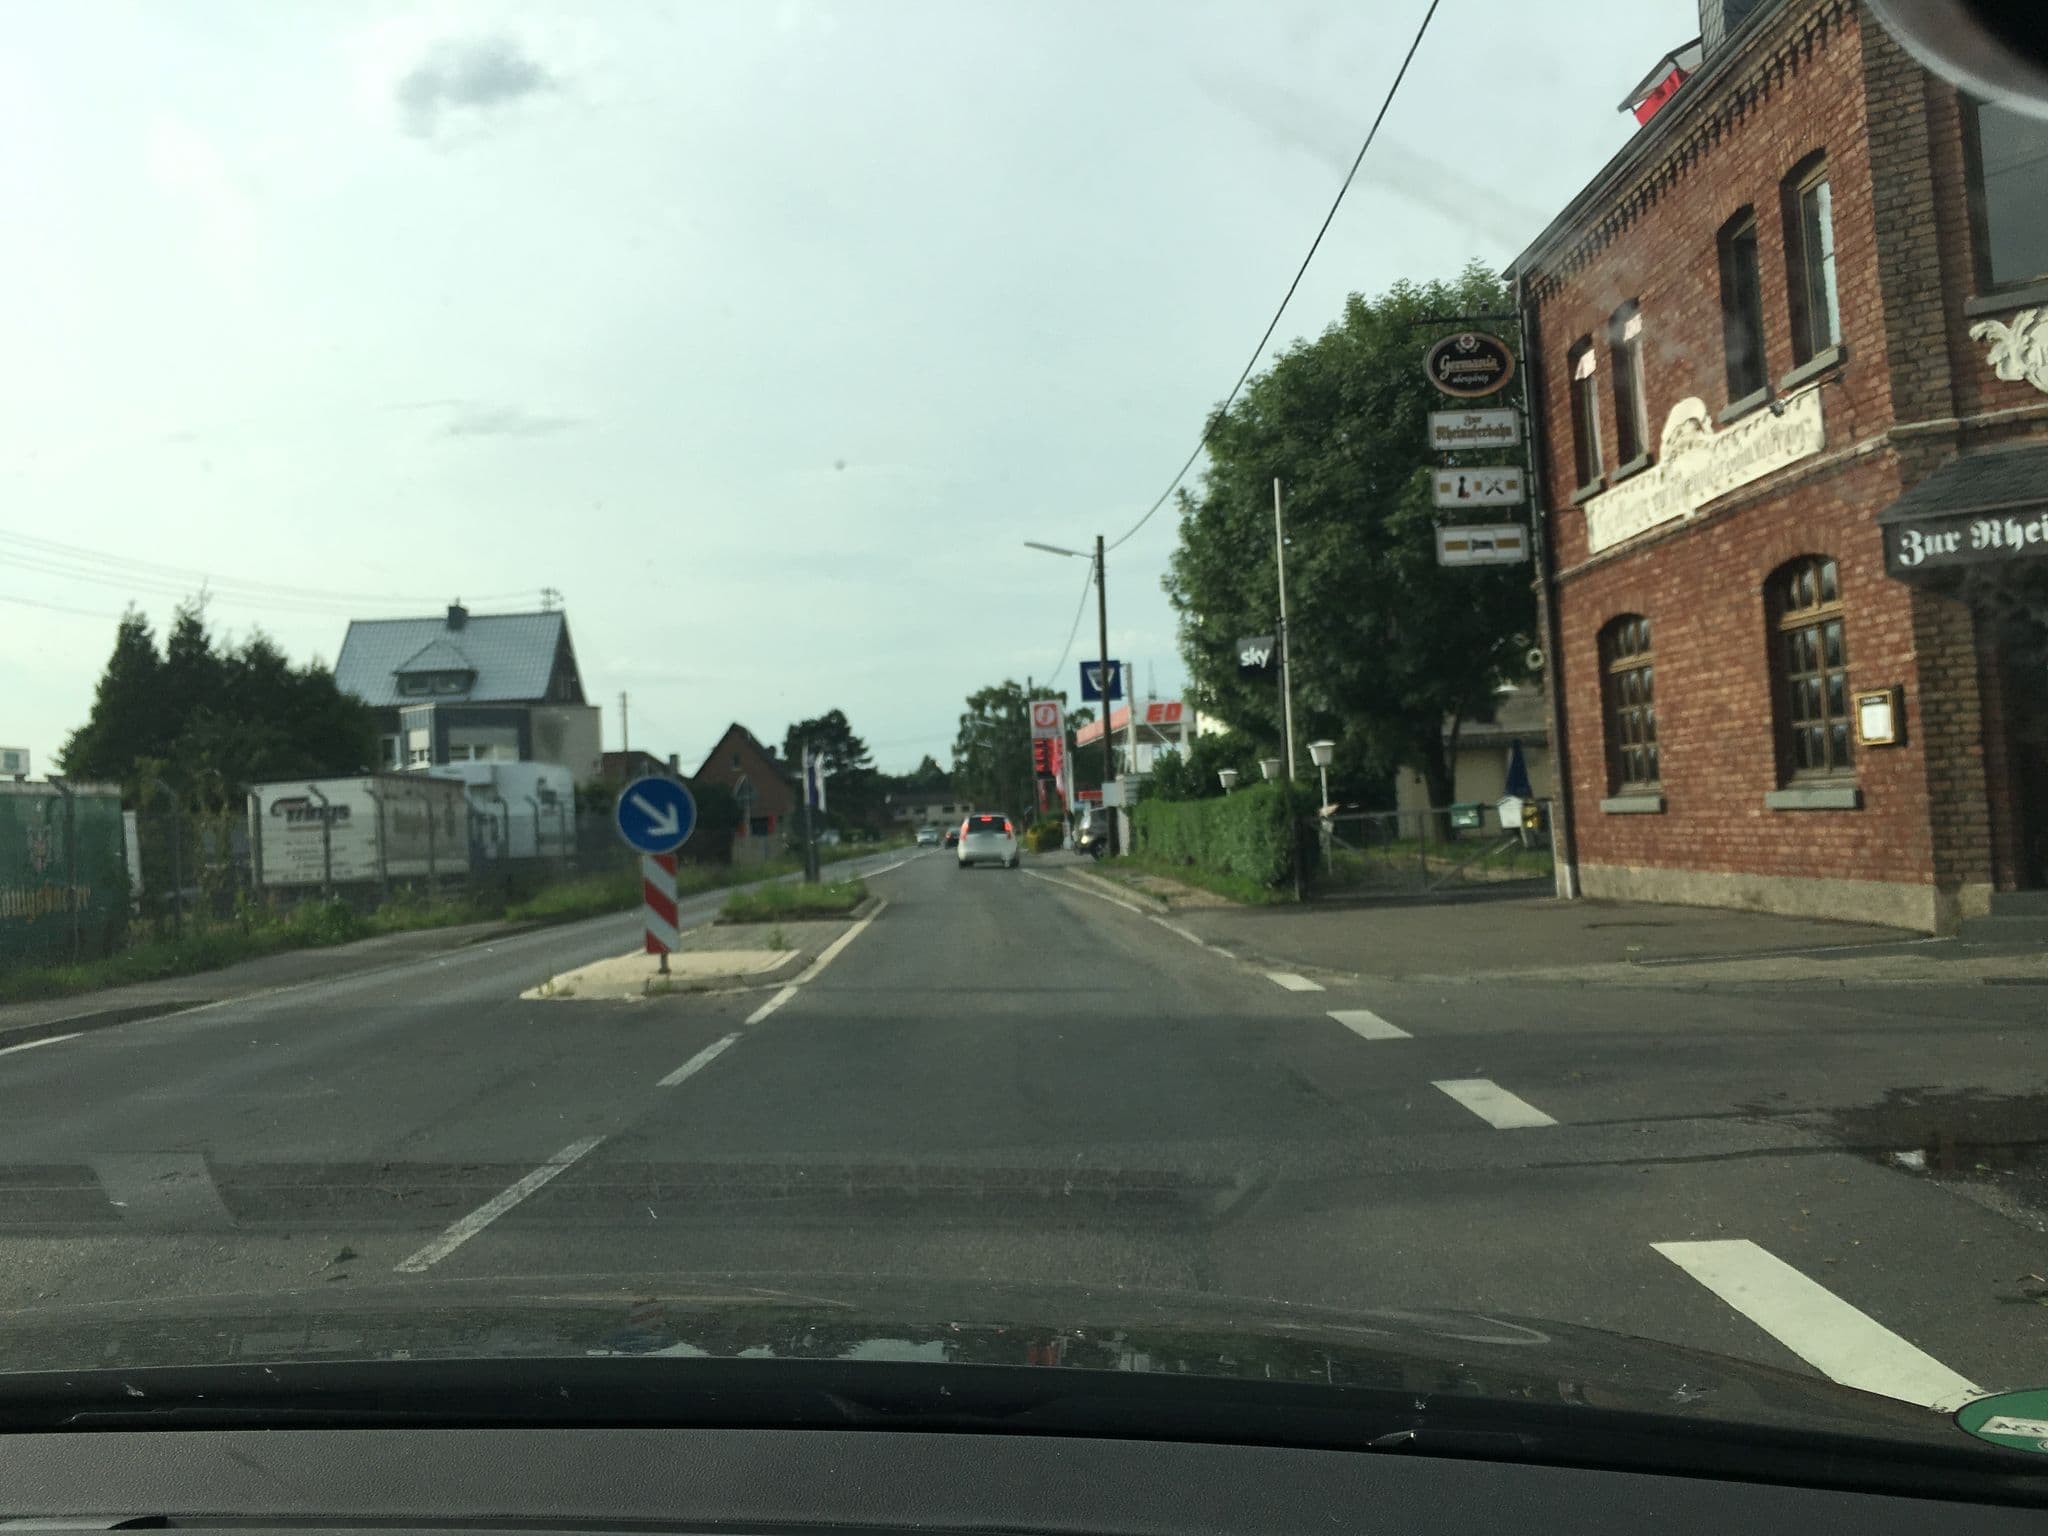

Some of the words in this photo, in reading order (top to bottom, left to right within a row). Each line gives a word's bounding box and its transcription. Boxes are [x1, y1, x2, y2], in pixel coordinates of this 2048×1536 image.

[1898, 530, 1961, 566] Zur
[1240, 646, 1270, 668] sky
[1145, 702, 1183, 722] ED
